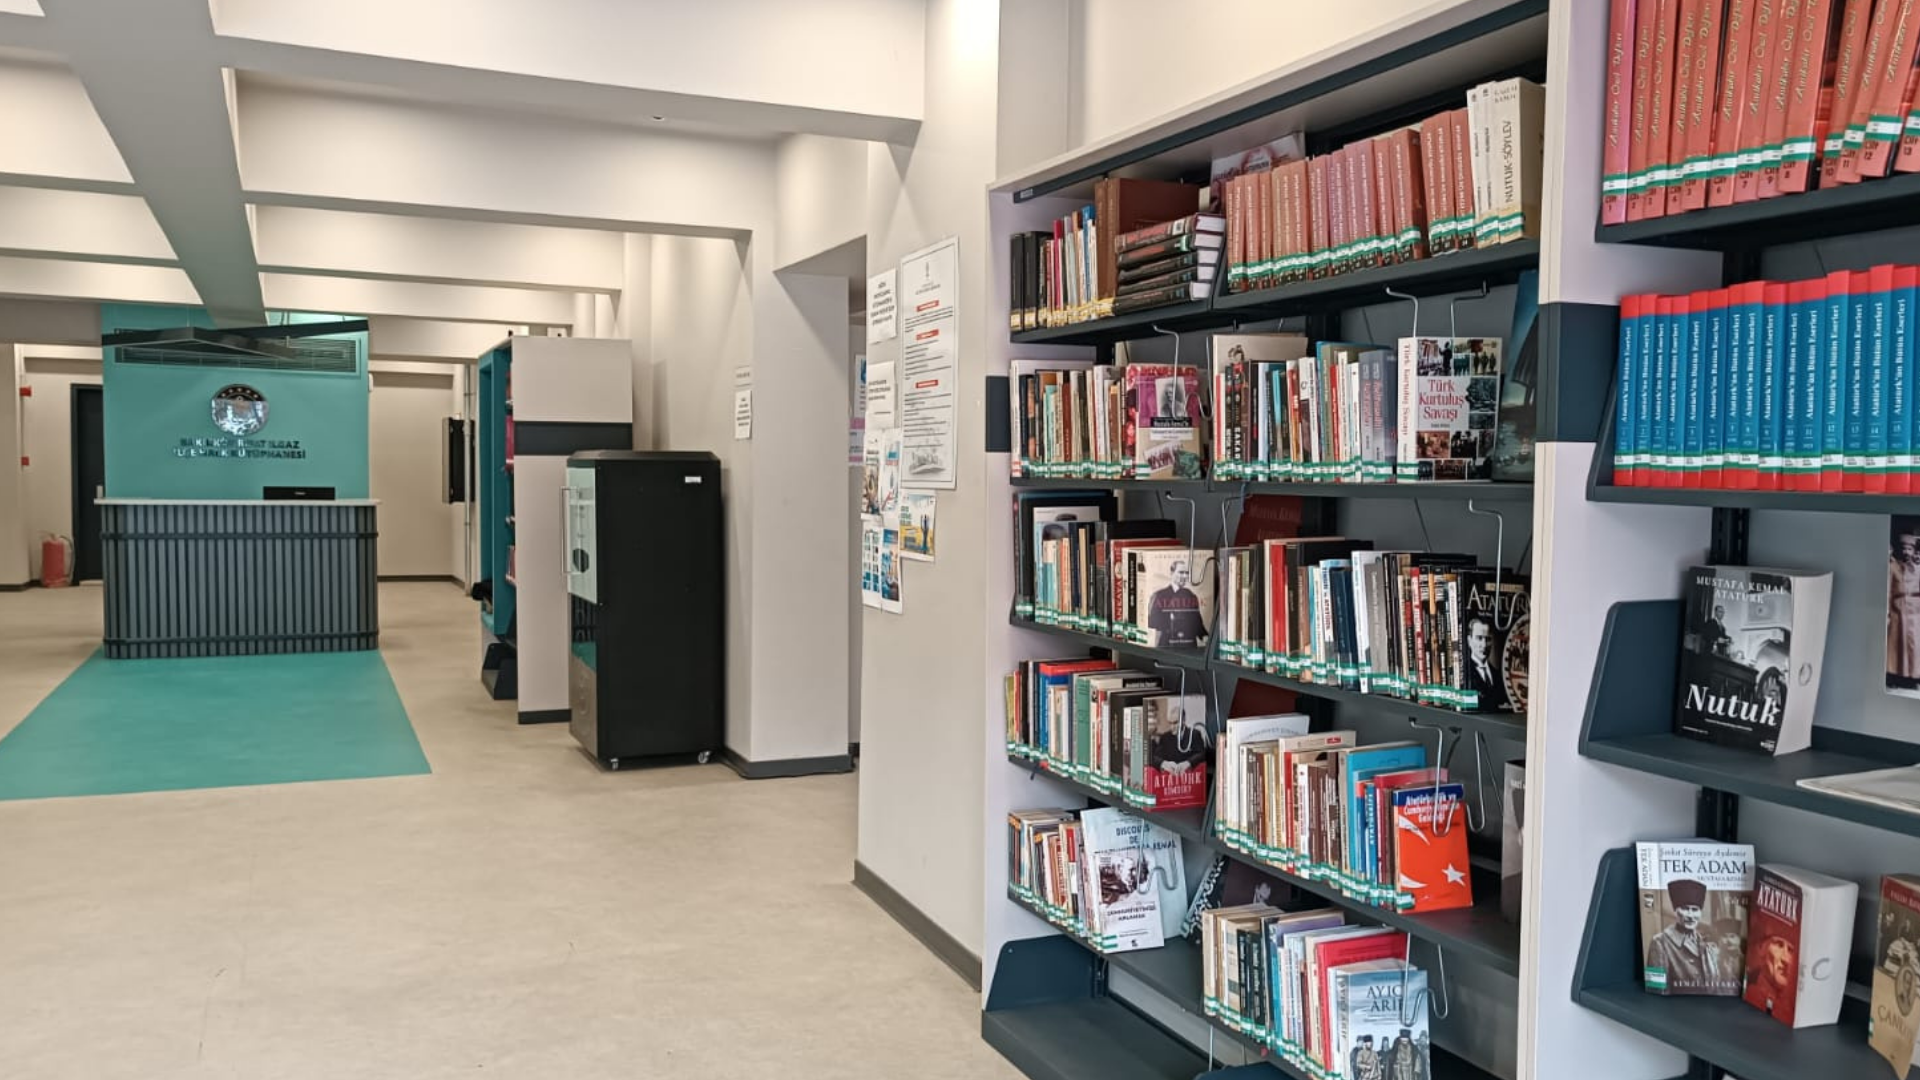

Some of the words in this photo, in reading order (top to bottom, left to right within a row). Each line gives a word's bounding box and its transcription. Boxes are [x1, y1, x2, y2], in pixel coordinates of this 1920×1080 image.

[1502, 120, 1514, 204] NUTUK-SÖYLEV
[1428, 380, 1455, 393] Türk
[1419, 392, 1465, 409] Kurtuluş
[1423, 406, 1459, 422] Savaşı
[1696, 576, 1745, 590] MUSTAFA
[1748, 582, 1785, 594] KEMAL
[1466, 583, 1531, 613] ATATÜR
[1684, 684, 1781, 727] Nutuk
[1116, 824, 1150, 837] DISCOUS
[1661, 860, 1692, 874] TEK
[1697, 860, 1748, 875] ADAM
[1757, 883, 1798, 926] ATATÜRK
[1366, 984, 1408, 1000] AYIC
